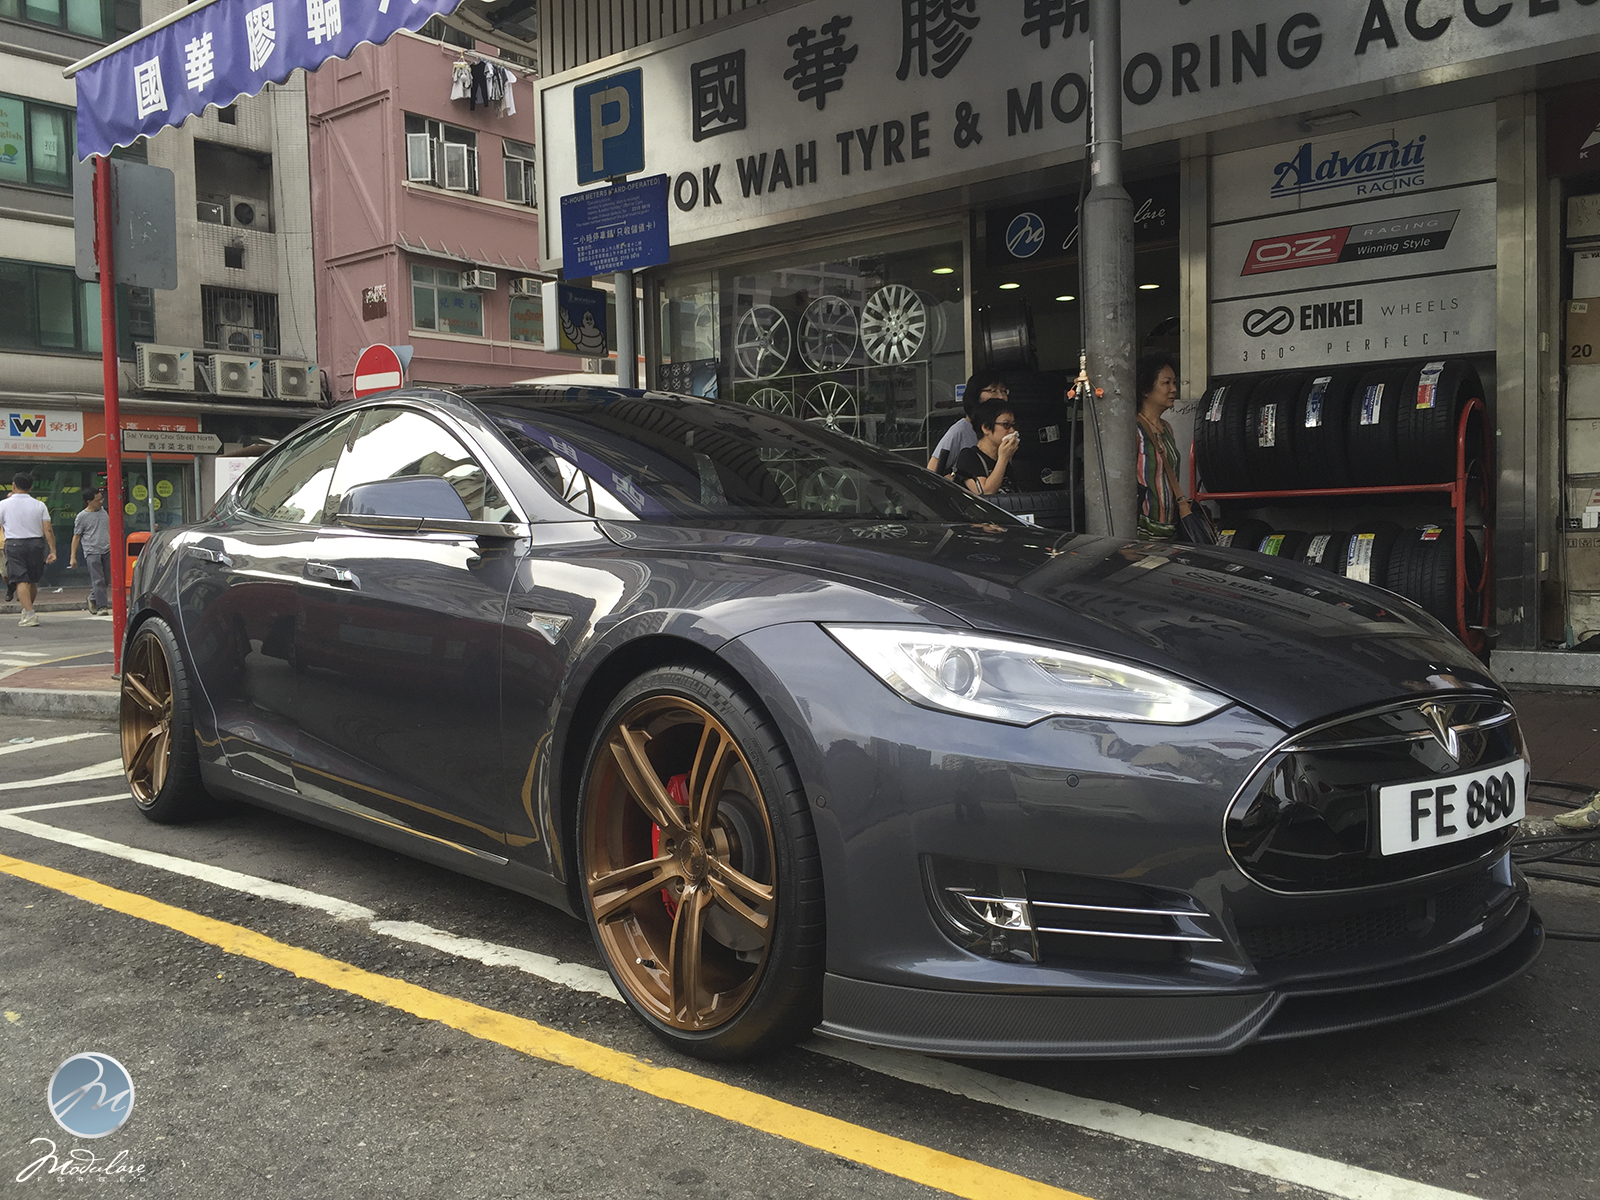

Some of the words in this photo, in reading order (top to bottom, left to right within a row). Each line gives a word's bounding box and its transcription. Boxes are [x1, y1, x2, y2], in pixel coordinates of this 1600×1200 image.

[133, 0, 418, 120] 國華膠輪
[667, 163, 722, 212] OK
[735, 140, 817, 198] WAH
[836, 111, 931, 176] TYRE
[953, 101, 983, 149] &
[1007, 12, 1323, 136] MOORING
[1354, 0, 1600, 55] ACC
[590, 86, 630, 172] P
[1271, 134, 1427, 190] Advanti
[585, 189, 607, 201] METERS
[1356, 174, 1425, 196] RACING
[1363, 219, 1439, 236] RACING
[1356, 242, 1399, 255] Winning
[1402, 236, 1430, 250] Style
[1300, 298, 1363, 331] ENKEI
[1380, 297, 1459, 316] WHEELS
[1243, 345, 1296, 362] 360°
[1571, 344, 1592, 358] 20
[1410, 784, 1458, 843] FE
[1466, 771, 1515, 830] 880
